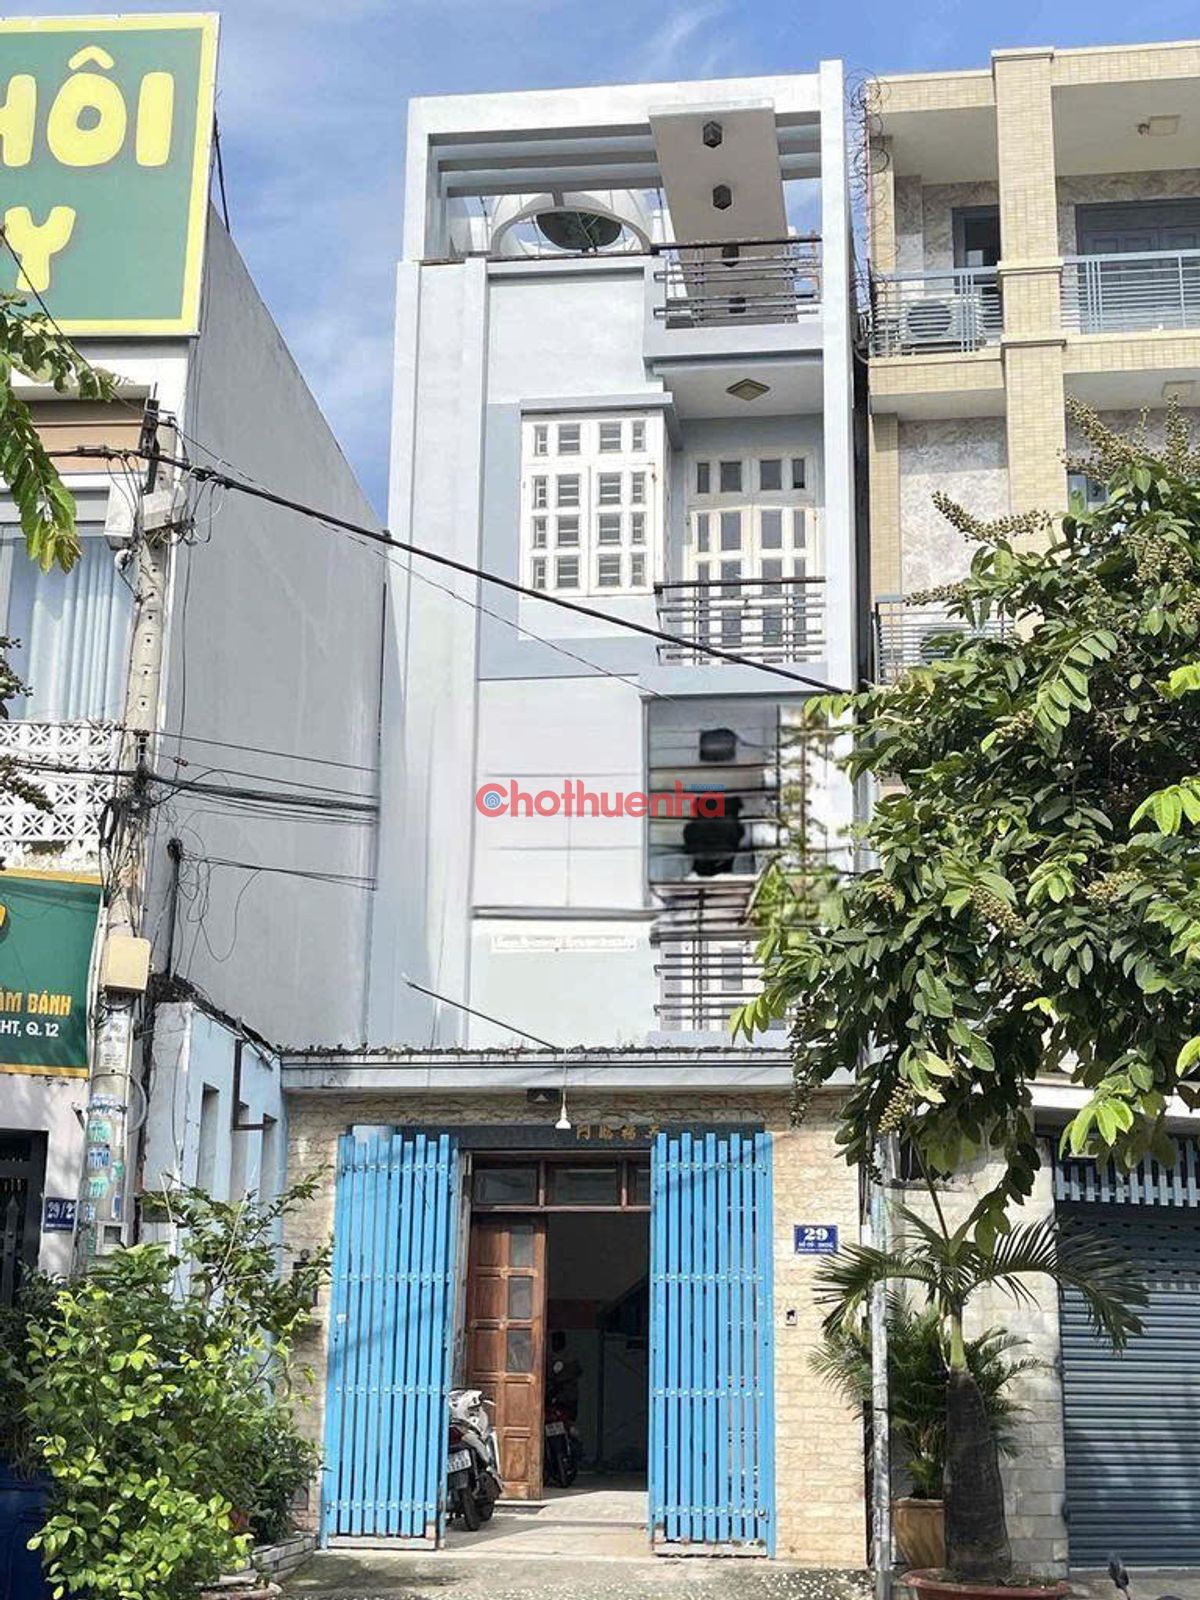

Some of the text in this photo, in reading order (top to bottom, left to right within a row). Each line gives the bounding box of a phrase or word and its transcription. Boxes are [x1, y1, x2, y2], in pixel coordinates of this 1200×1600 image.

[27, 990, 72, 1016] BÁNH
[0, 1020, 21, 1037] HT,
[804, 1228, 828, 1241] 29
